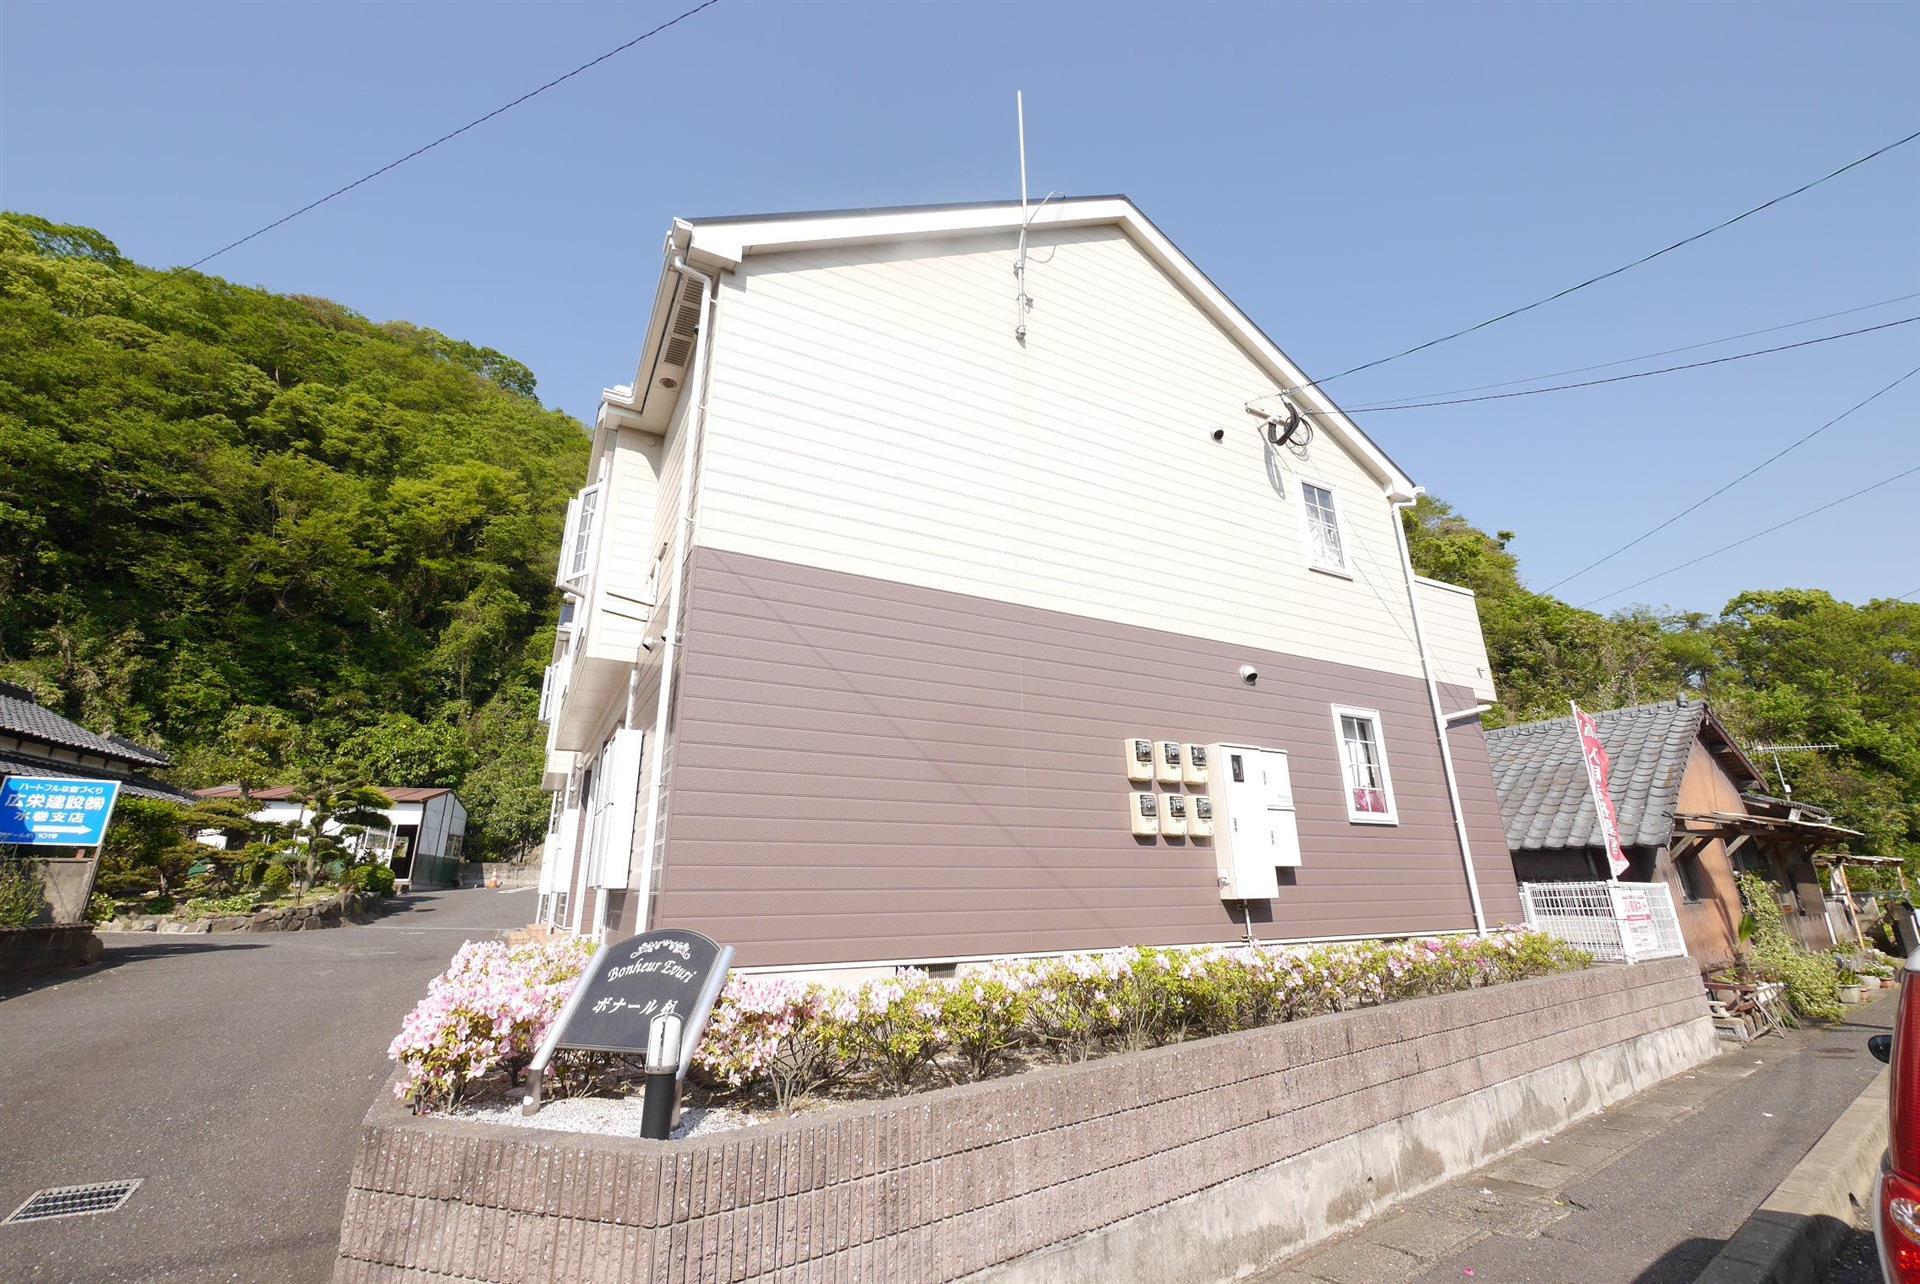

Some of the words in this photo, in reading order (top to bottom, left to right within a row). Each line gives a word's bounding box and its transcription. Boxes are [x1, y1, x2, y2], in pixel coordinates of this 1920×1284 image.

[14, 811, 85, 824] 水巻支店
[608, 958, 662, 982] Bonheur
[661, 960, 697, 983] Evuri
